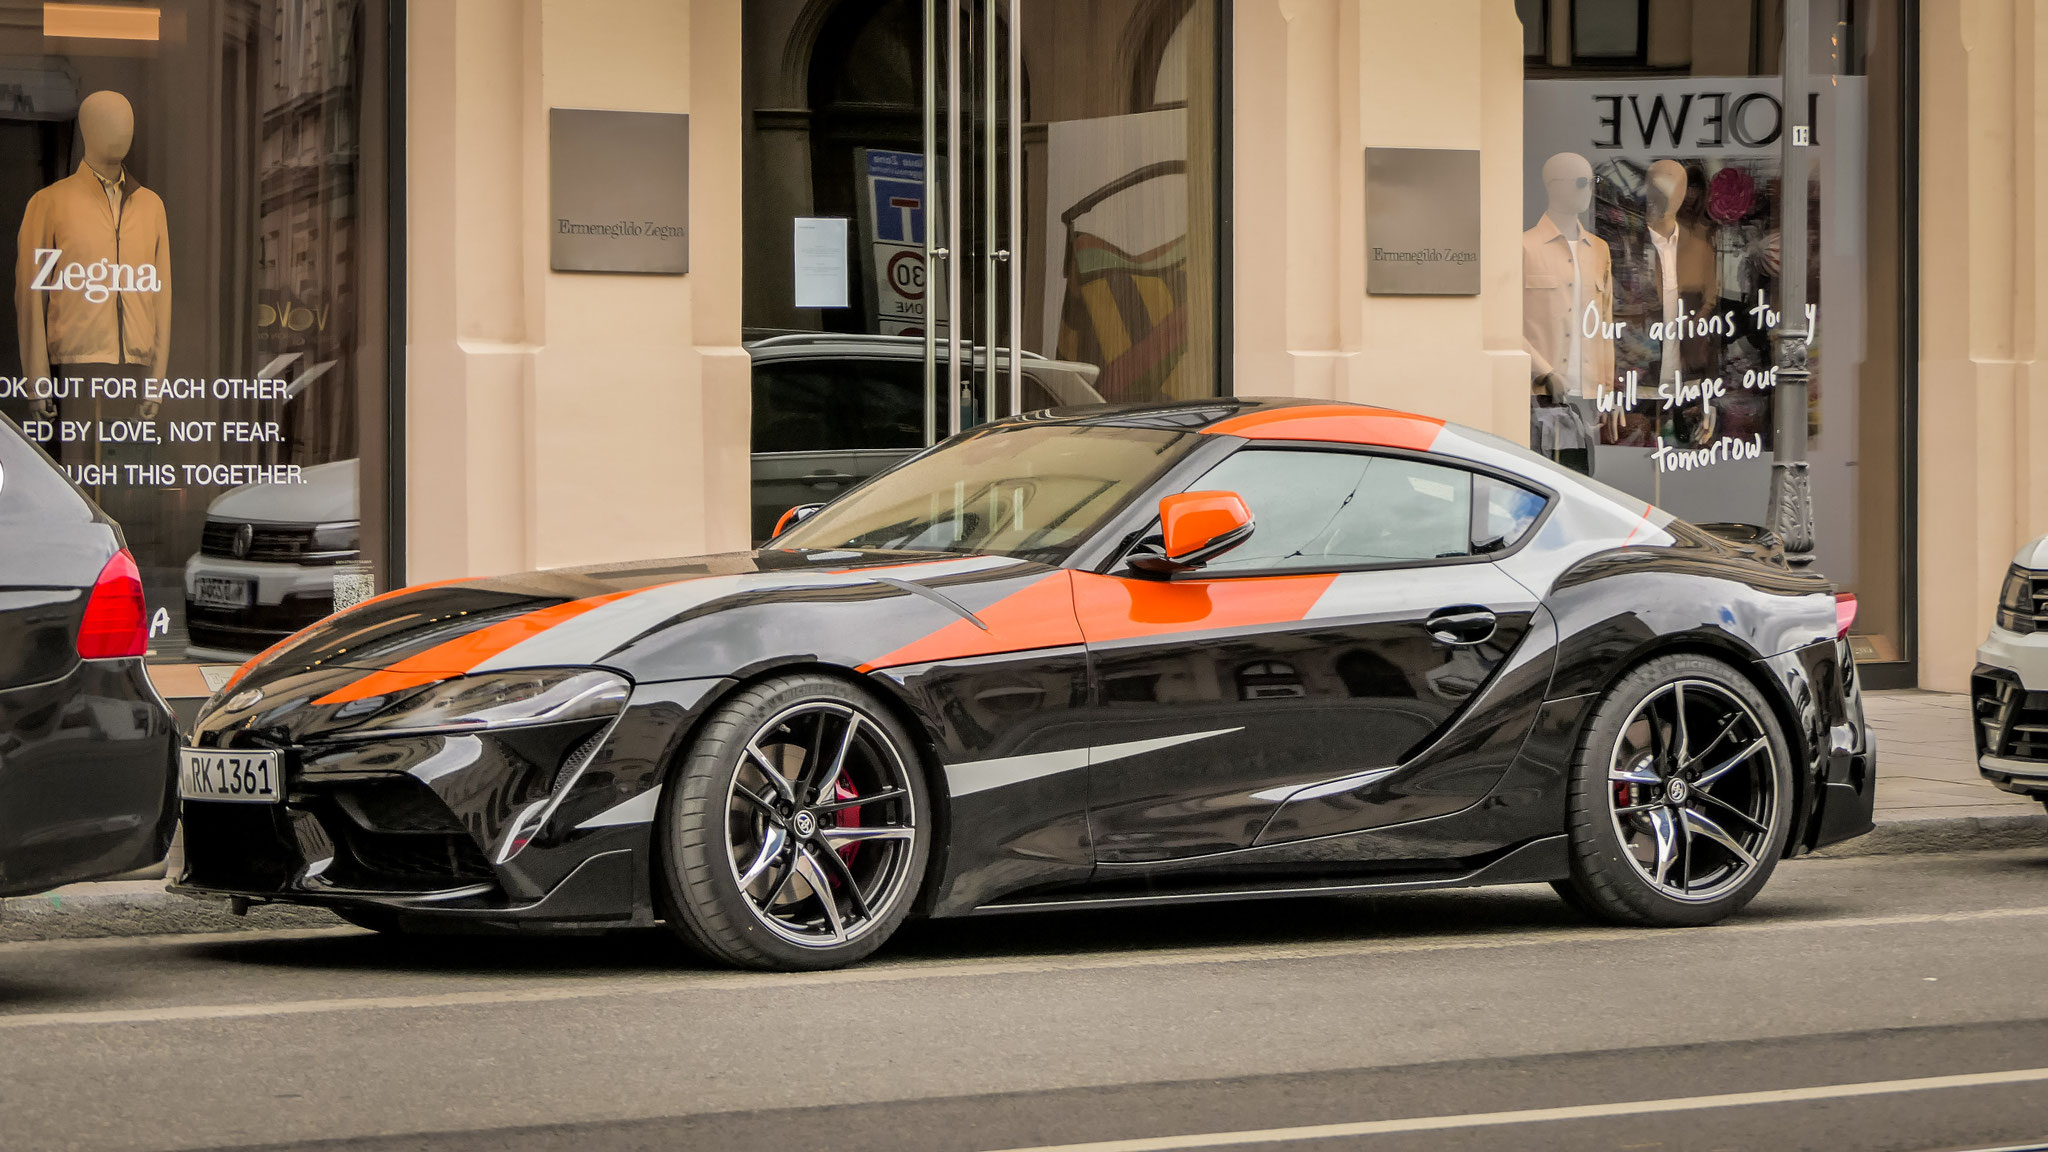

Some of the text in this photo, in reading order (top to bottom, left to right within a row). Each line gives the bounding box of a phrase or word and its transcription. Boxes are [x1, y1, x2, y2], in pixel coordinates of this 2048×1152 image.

[557, 219, 685, 240] Ermenegildo Zegna
[1372, 247, 1477, 265] Ermenegildo Zegna
[30, 248, 162, 303] Zegna
[1582, 288, 1817, 346] Our actions toy
[35, 377, 84, 399] OUT
[91, 377, 137, 399] FOR
[144, 378, 205, 399] EACH
[212, 378, 294, 400] OTHER.
[1596, 365, 1779, 414] will shape our
[61, 421, 91, 442] BY
[99, 421, 162, 445] LOVE,
[170, 421, 216, 442] NOT
[223, 422, 286, 443] FEAR.
[1651, 433, 1761, 473] tomorrow
[59, 464, 308, 486] UGH THIS TOGETHER.
[192, 757, 273, 794] RK 1361
